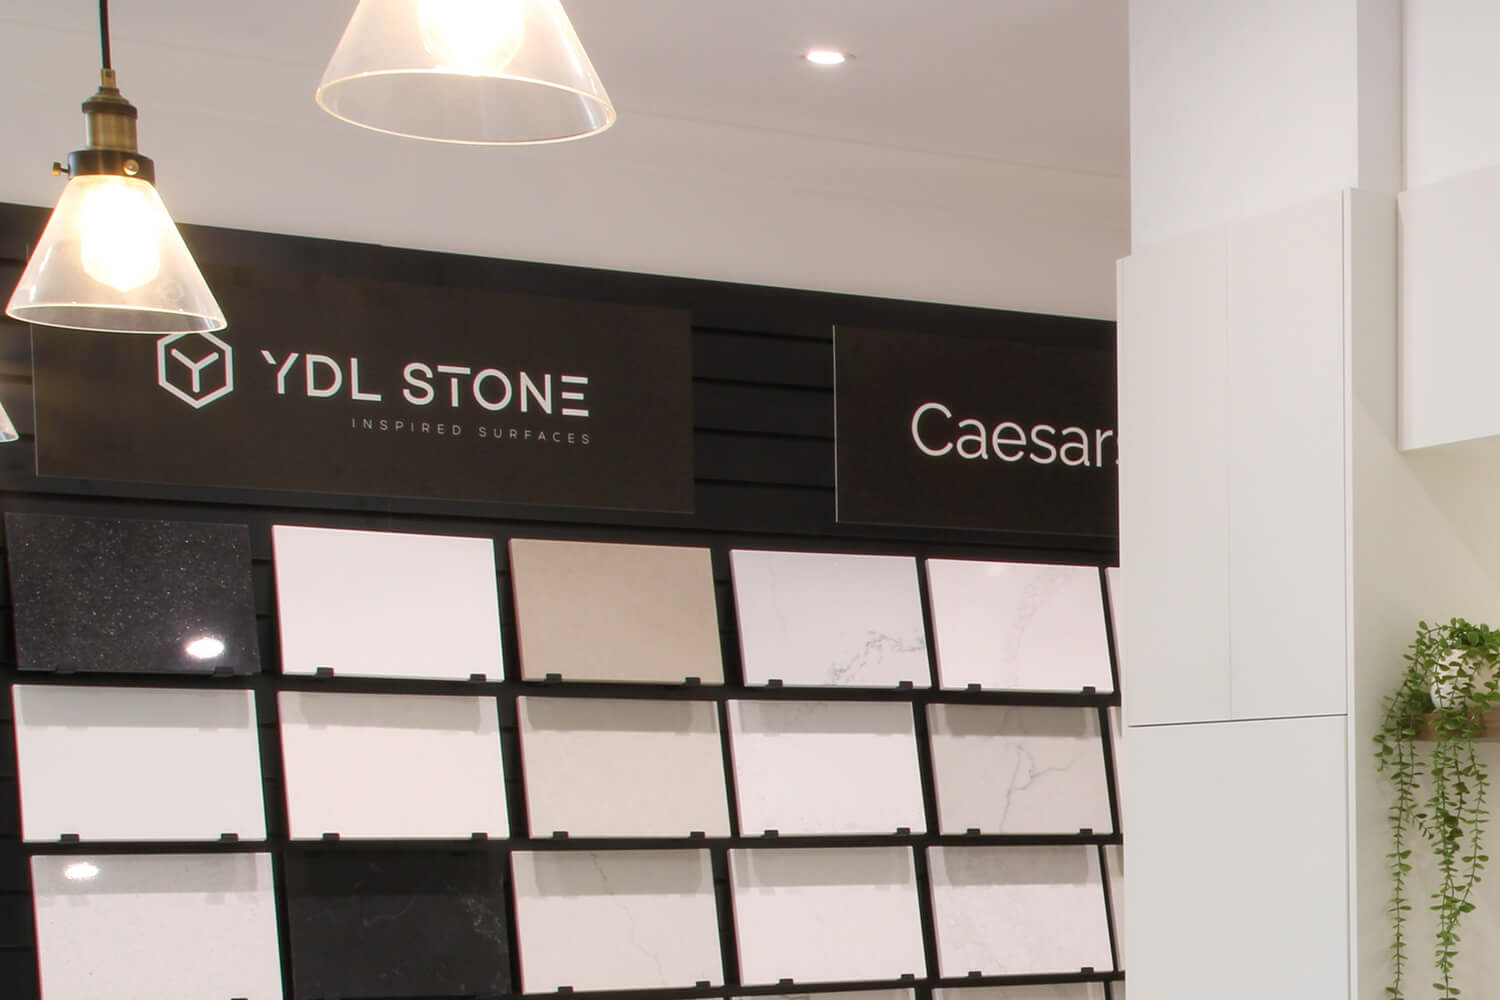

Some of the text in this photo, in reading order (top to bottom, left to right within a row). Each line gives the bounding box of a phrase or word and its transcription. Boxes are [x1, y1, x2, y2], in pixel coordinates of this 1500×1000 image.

[260, 349, 590, 417] YDL STONE
[351, 417, 591, 446] INSPIRED SURFACES
[911, 402, 1119, 467] Caesar
